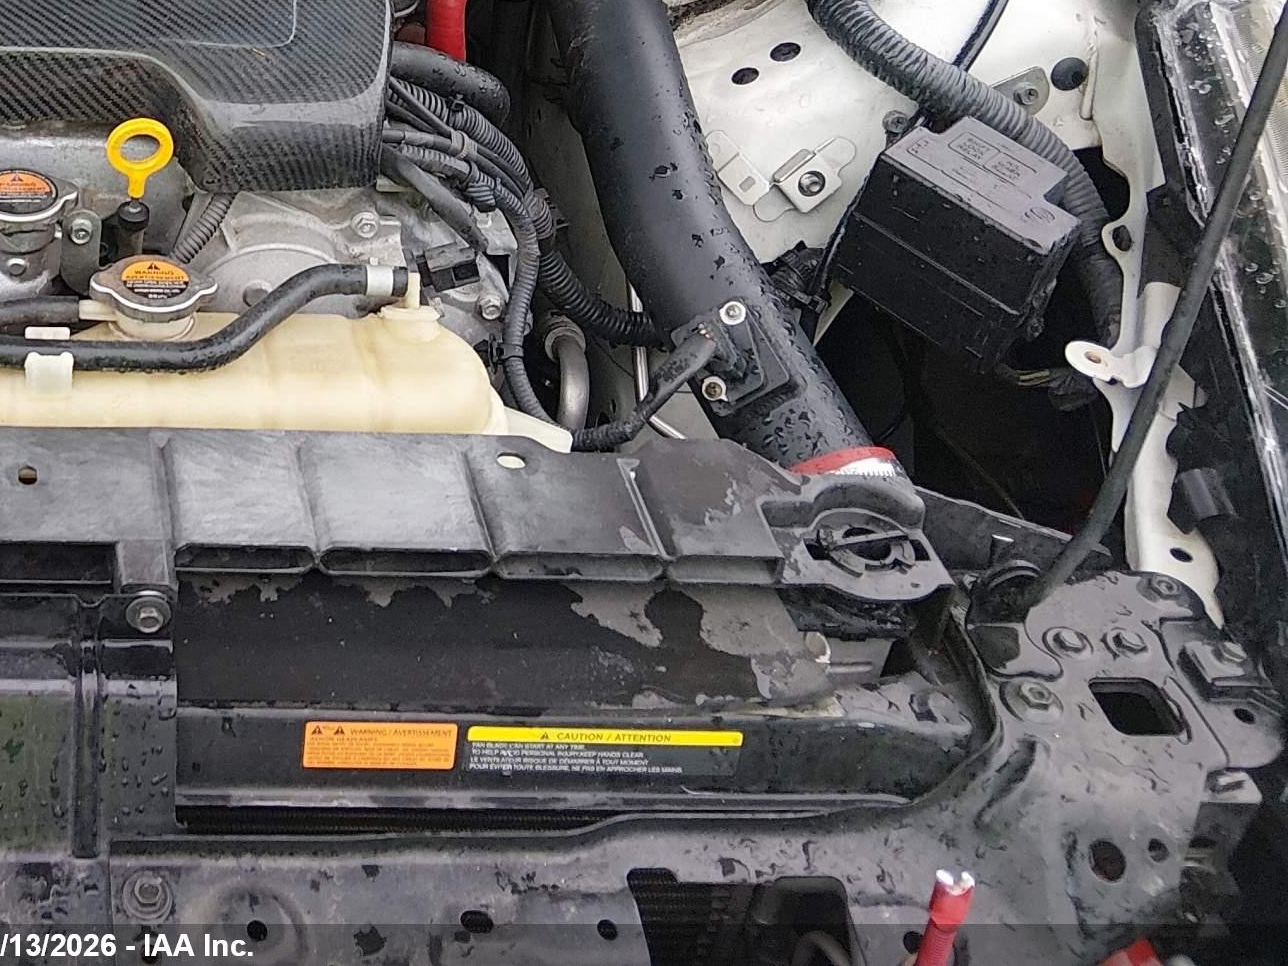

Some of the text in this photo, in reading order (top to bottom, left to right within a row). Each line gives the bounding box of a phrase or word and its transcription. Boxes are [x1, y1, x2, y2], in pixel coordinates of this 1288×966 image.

[350, 728, 386, 736] WARNING
[556, 732, 603, 740] CAUTION
[614, 734, 671, 742] ATTENTION
